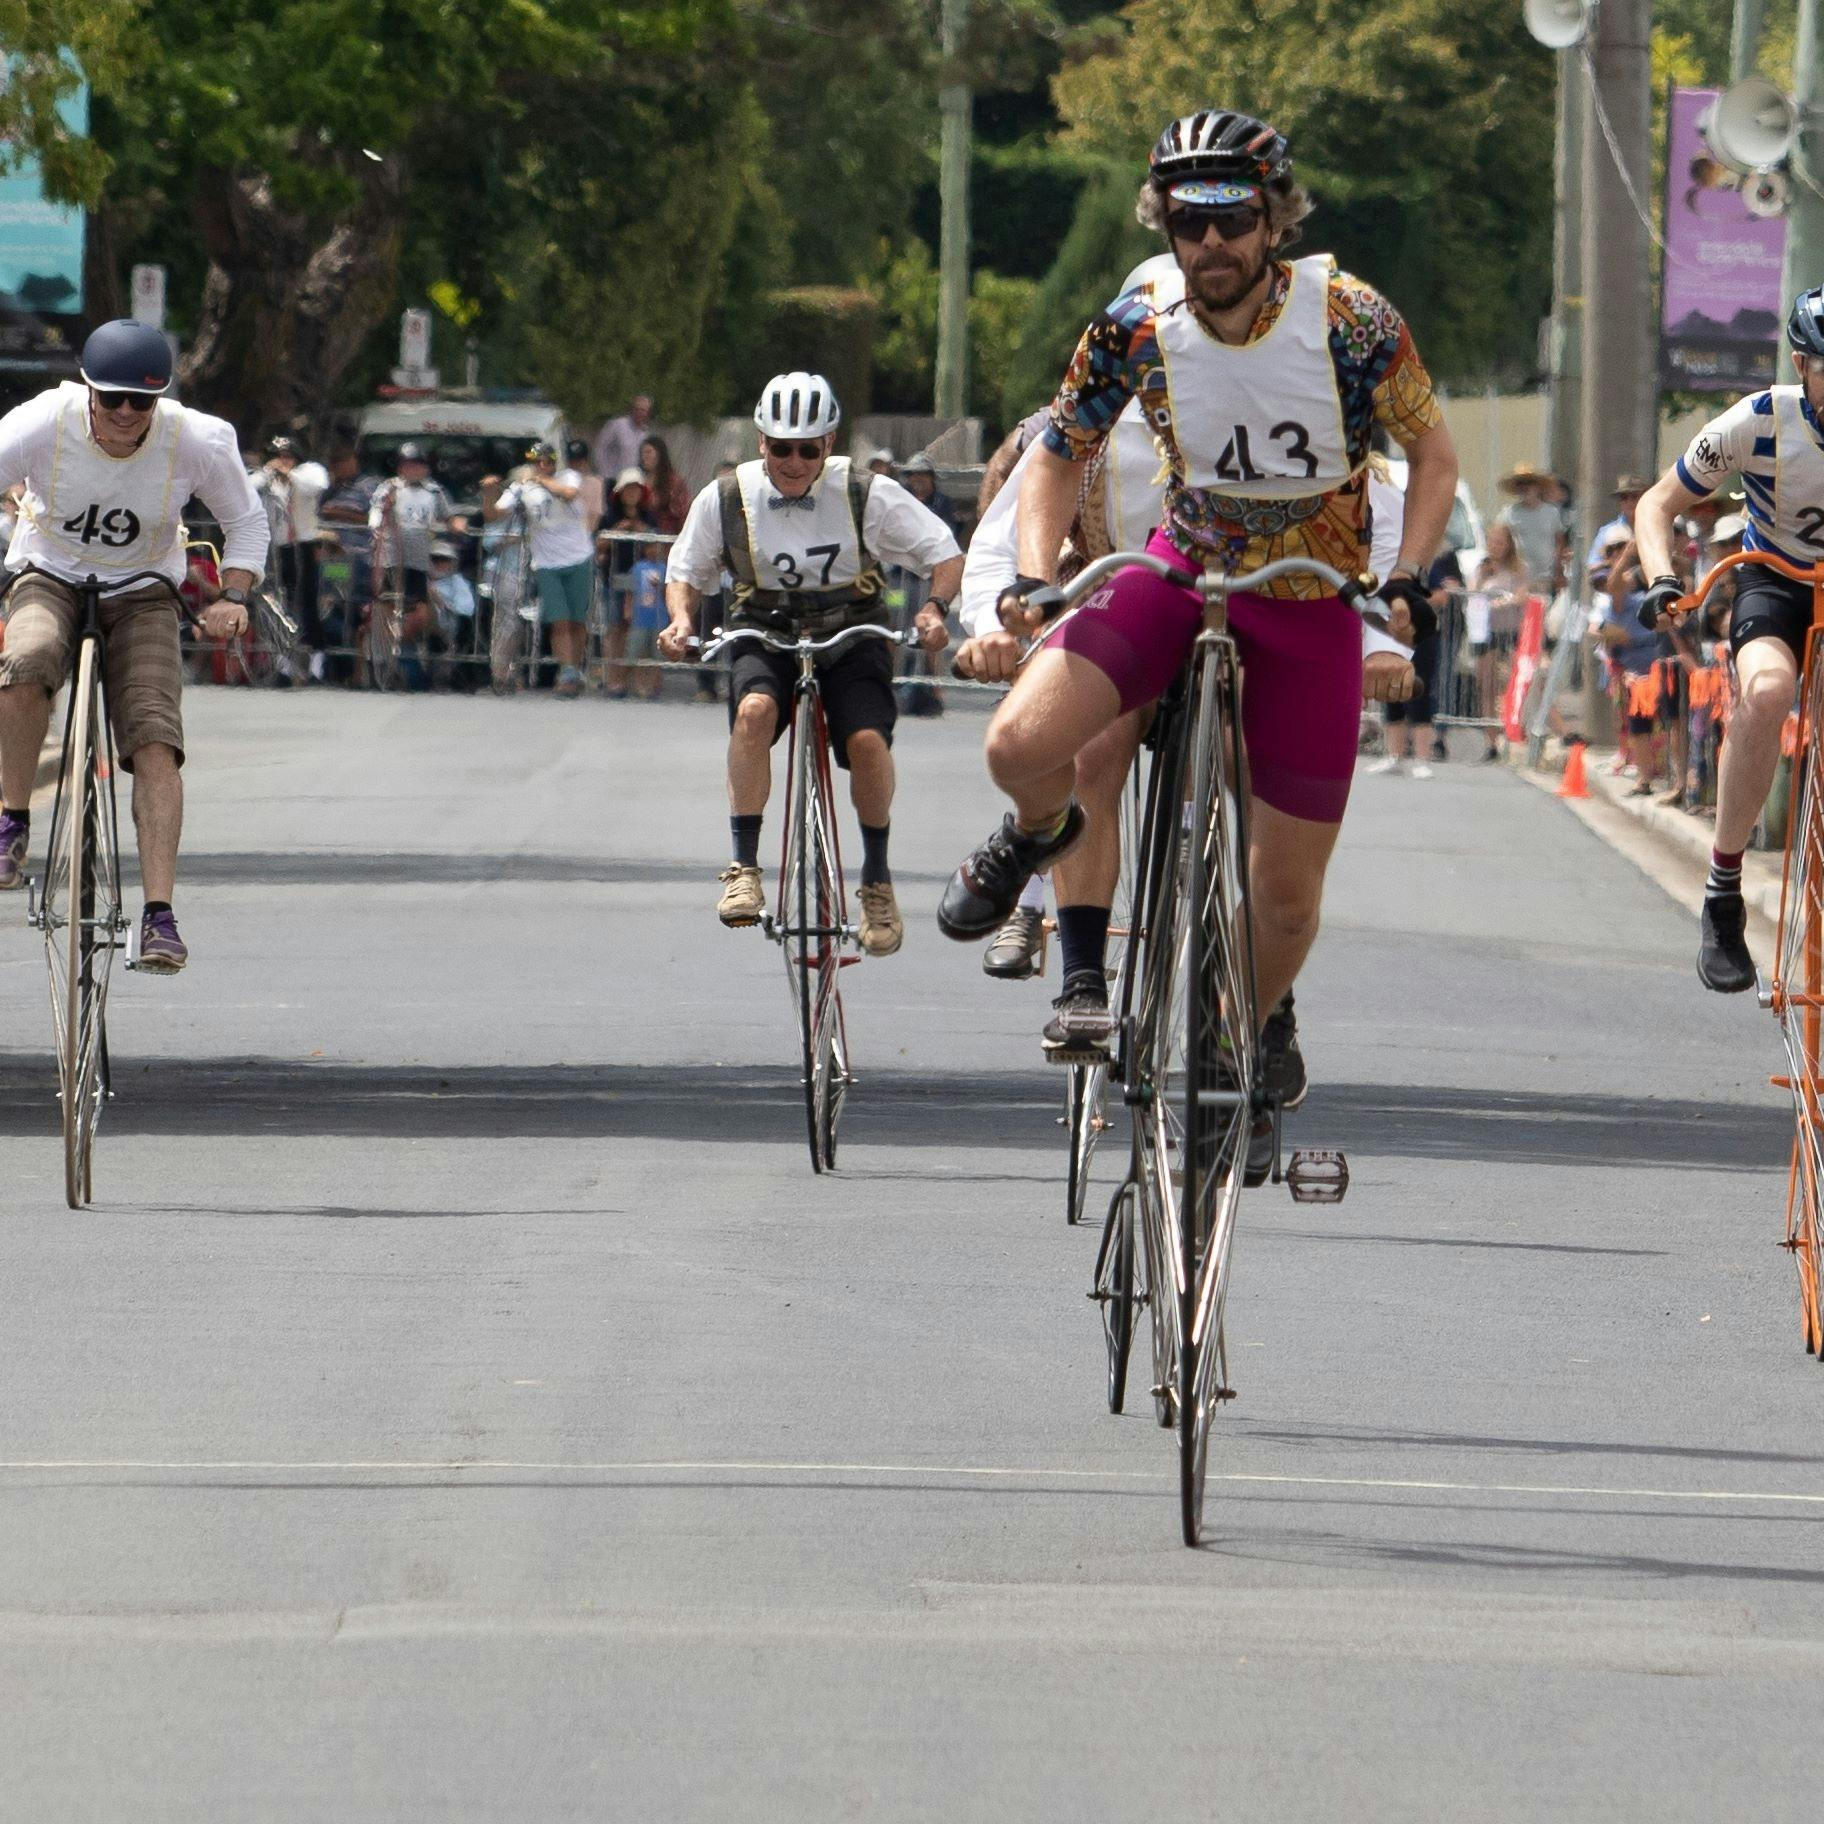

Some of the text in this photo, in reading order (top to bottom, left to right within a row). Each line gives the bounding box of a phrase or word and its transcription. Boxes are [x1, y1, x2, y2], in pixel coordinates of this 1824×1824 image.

[1215, 421, 1319, 482] 43
[63, 504, 140, 547] 49
[771, 543, 842, 591] 37
